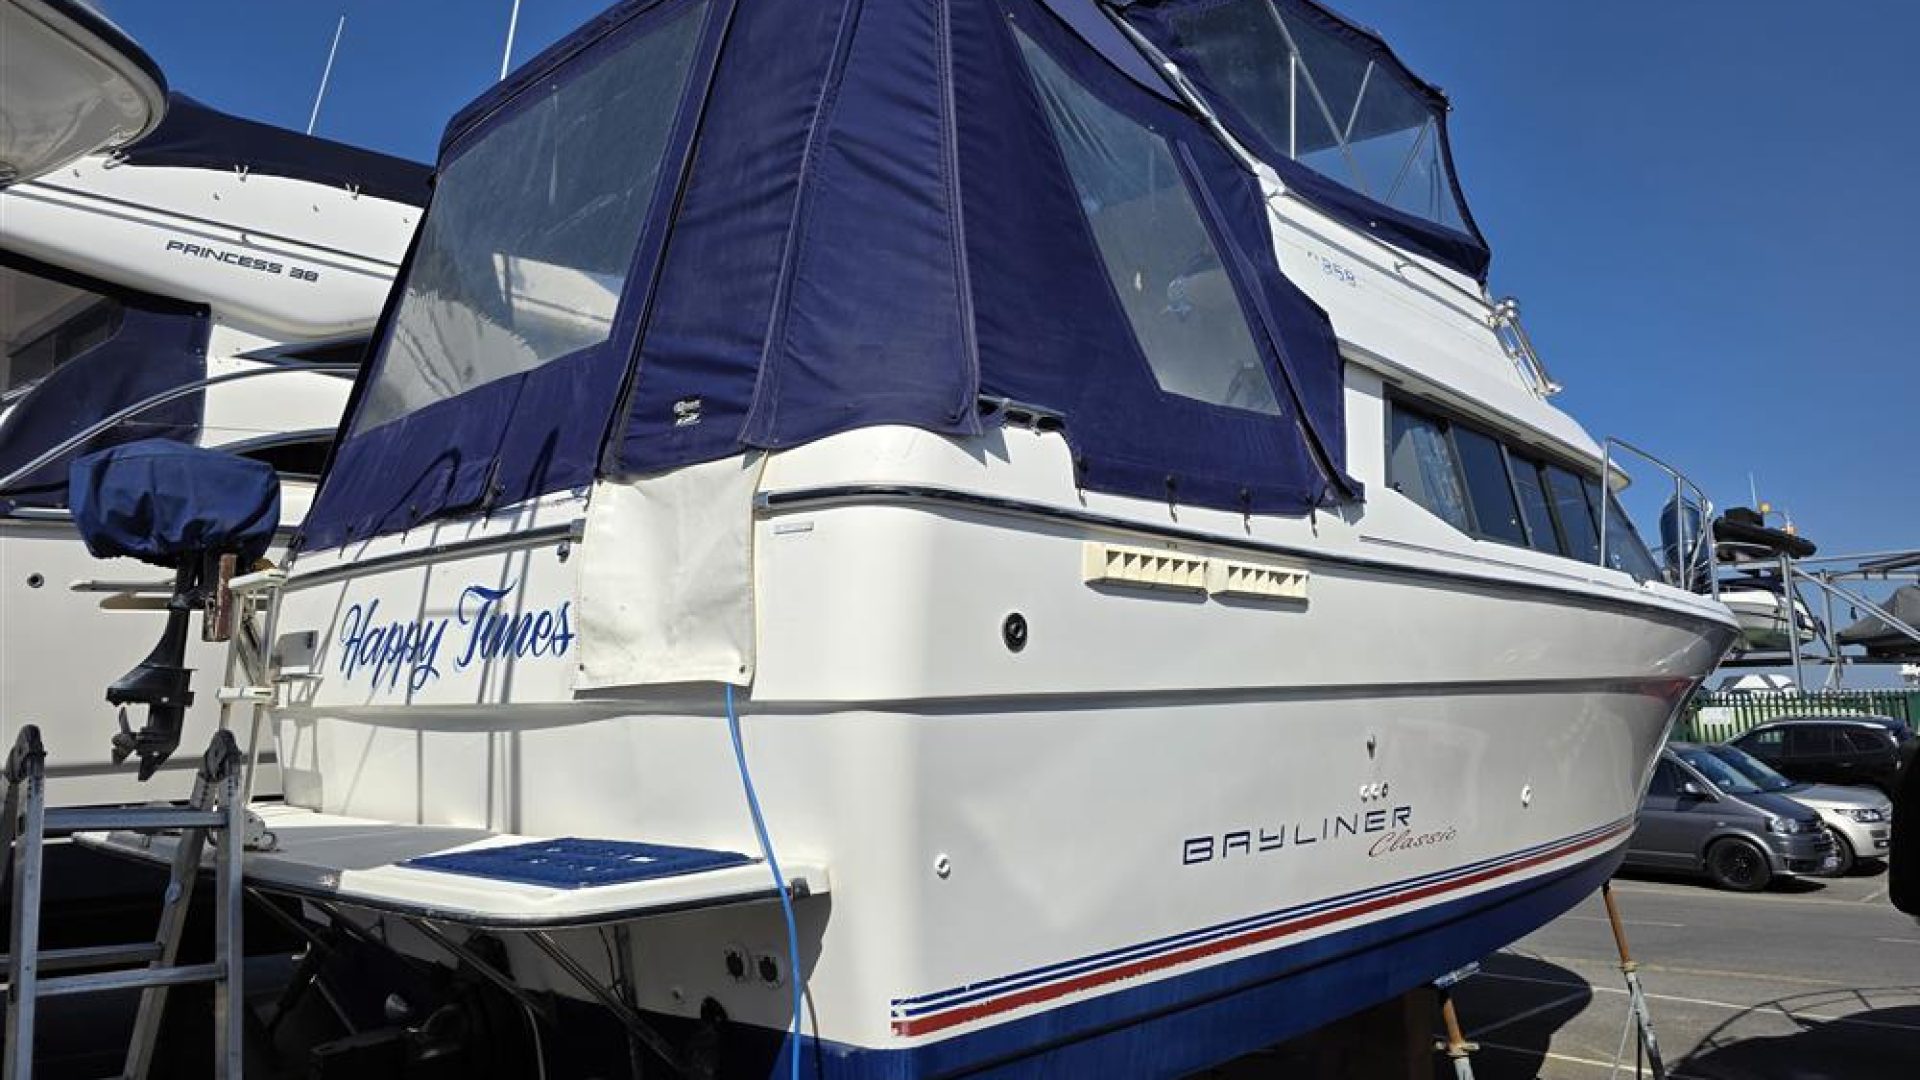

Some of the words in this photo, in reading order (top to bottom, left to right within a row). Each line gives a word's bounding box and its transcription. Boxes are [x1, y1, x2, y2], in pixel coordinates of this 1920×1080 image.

[166, 239, 283, 274] PRINCESS
[340, 598, 448, 691] Happy
[455, 578, 575, 669] Times
[1182, 806, 1412, 866] BAYLINER
[1368, 827, 1458, 858] Classic
